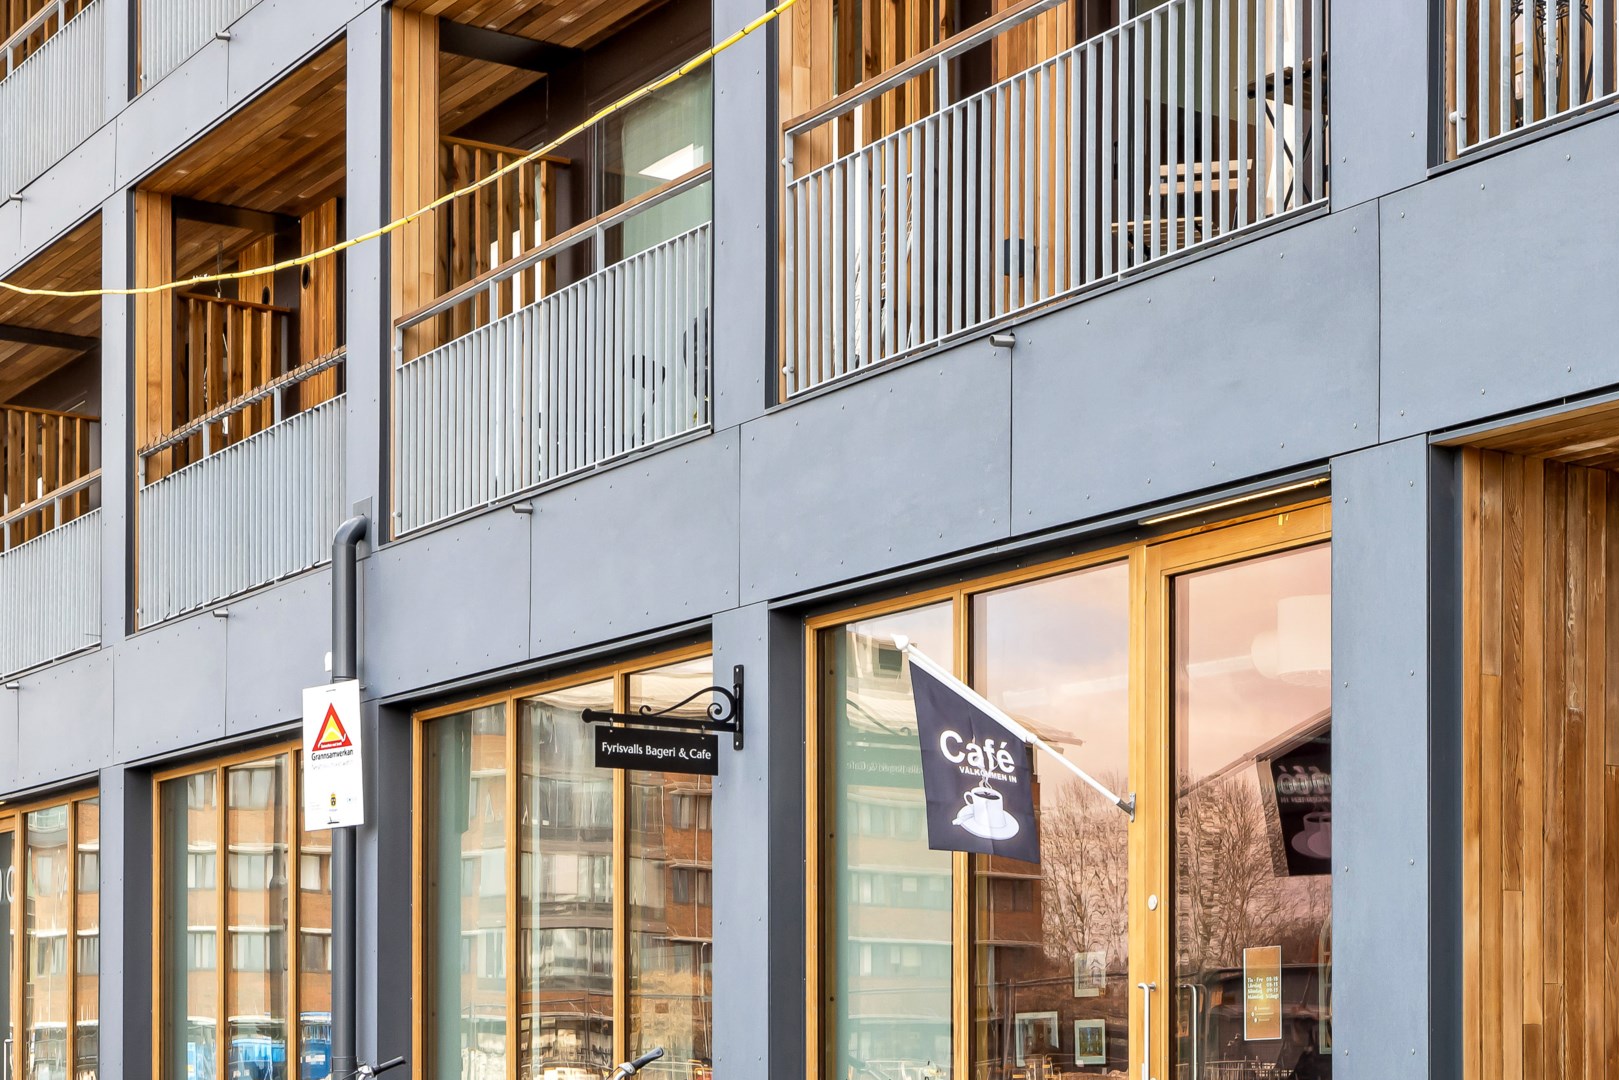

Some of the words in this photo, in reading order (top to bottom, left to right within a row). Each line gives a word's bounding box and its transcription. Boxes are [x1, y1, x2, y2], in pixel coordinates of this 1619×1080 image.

[311, 748, 354, 761] Grannsamverkan
[601, 741, 643, 755] Fyrisvalls
[645, 745, 676, 759] Bageri
[678, 747, 690, 760] &
[689, 748, 712, 760] Cafe
[940, 730, 1016, 774] Café
[1008, 775, 1018, 784] IN
